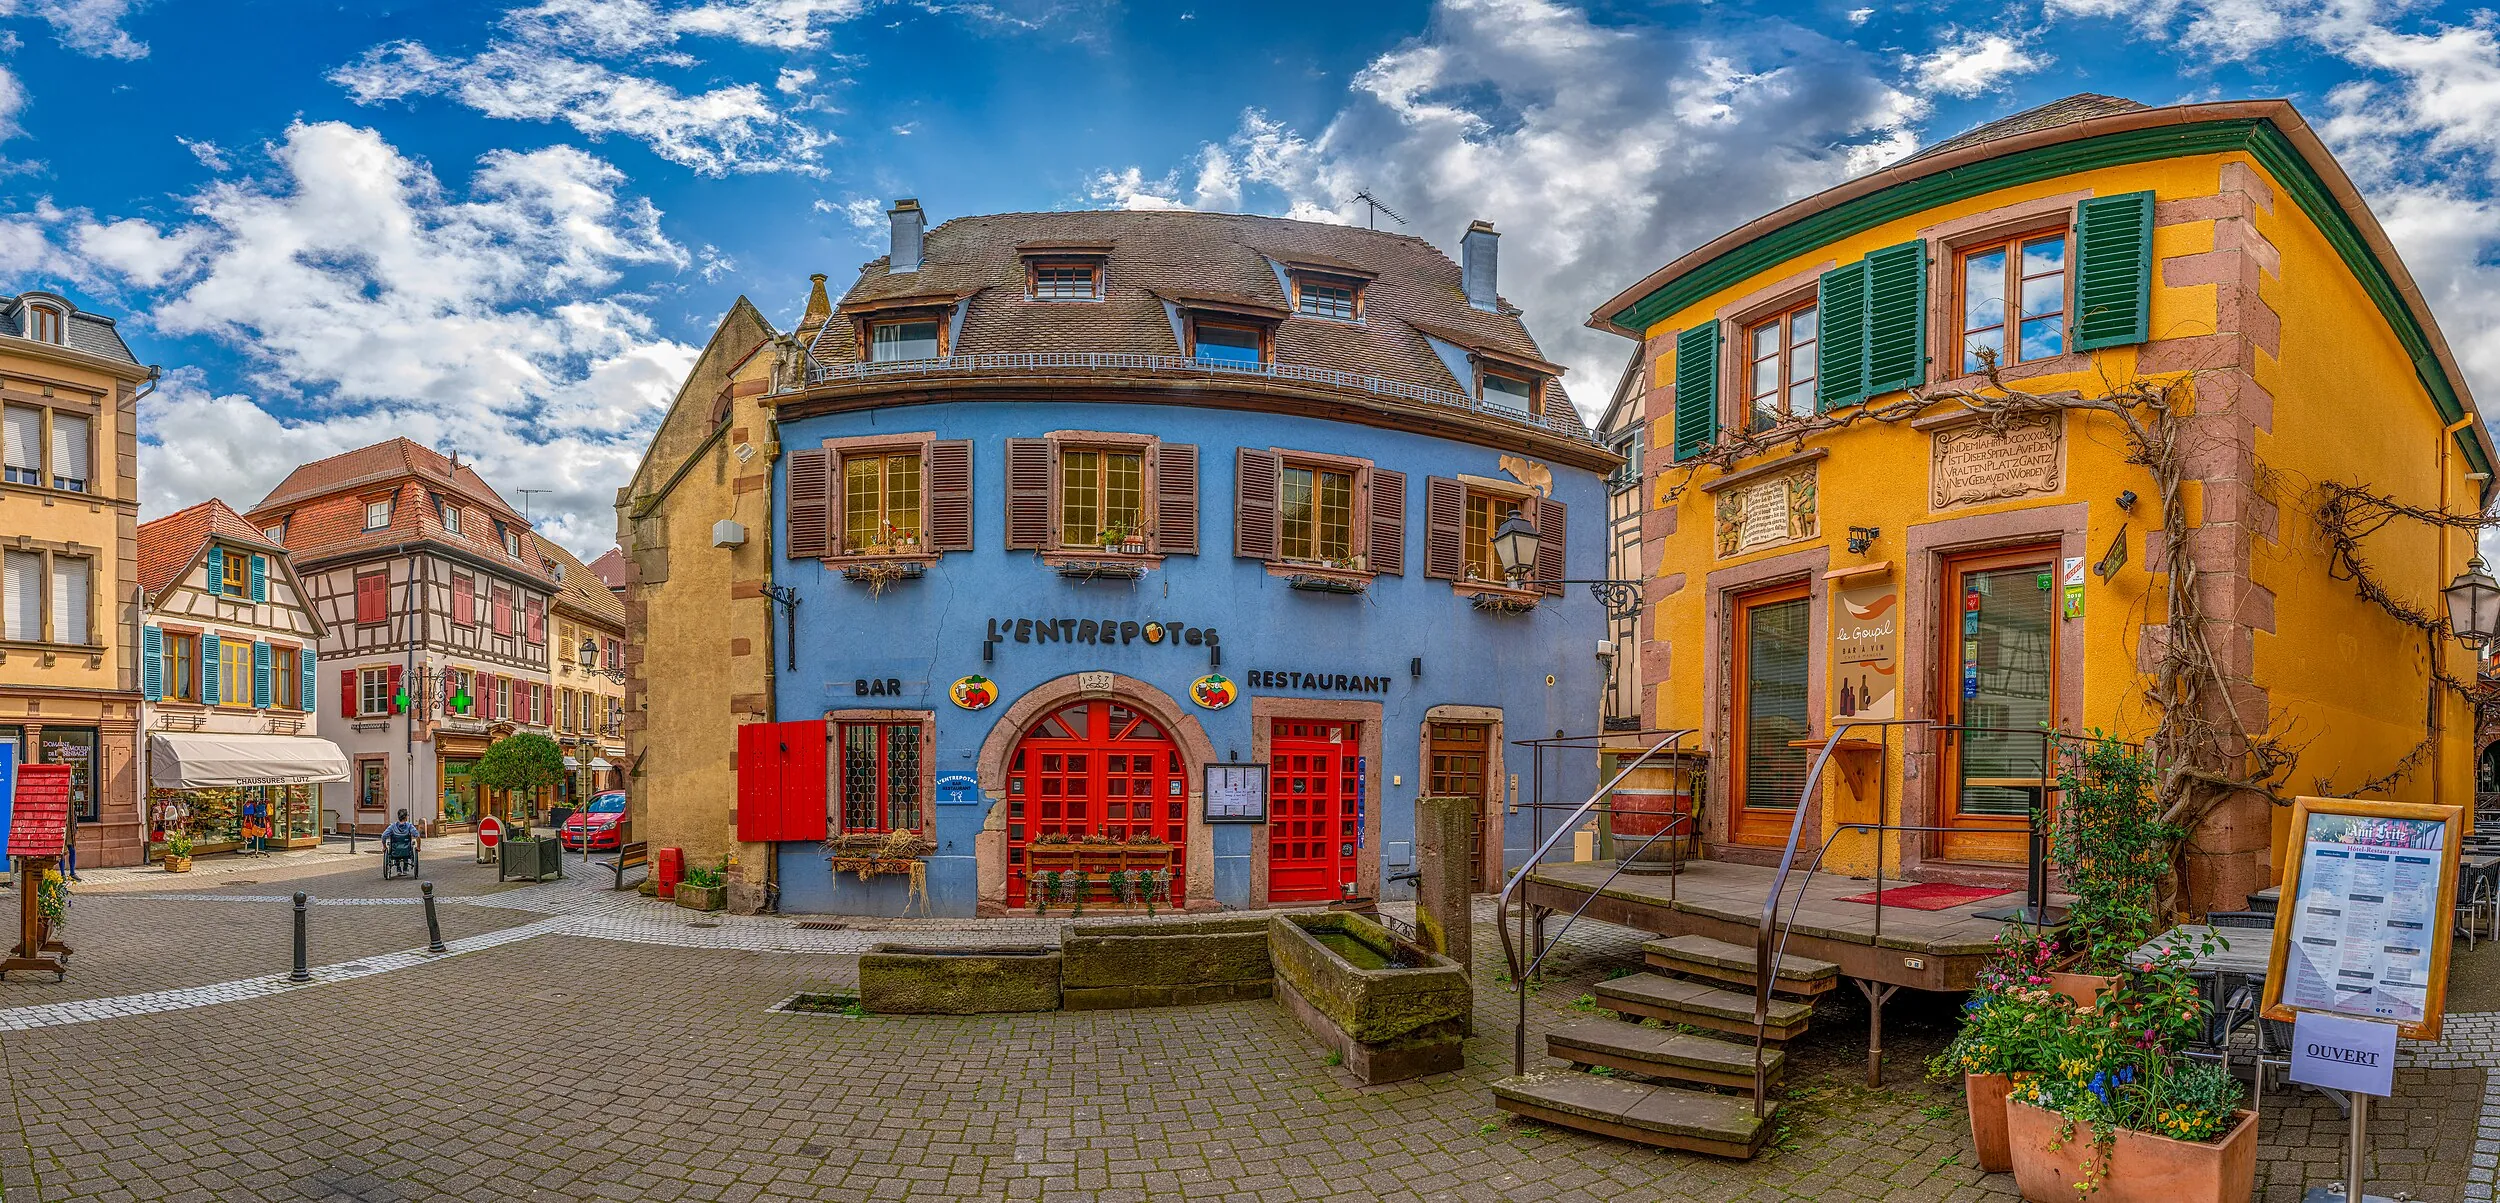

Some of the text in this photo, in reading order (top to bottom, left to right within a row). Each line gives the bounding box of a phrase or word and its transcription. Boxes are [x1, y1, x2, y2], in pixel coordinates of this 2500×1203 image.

[1948, 441, 2053, 466] IST DISER SPITAL AVF DEN
[1958, 441, 1978, 453] DEM
[1944, 453, 2053, 478] VRALTEN PLATZ GANTZ
[1968, 472, 2010, 486] GEBAVEN
[2009, 466, 2048, 480] WORDEN
[1852, 619, 1894, 646] Goupil
[1842, 646, 1856, 655] BAR
[1870, 644, 1885, 652] VIN
[855, 678, 901, 696] BAR
[1247, 669, 1392, 693] RESTAURANT
[236, 776, 309, 786] CHAUSSURES LUTZ
[2307, 1043, 2380, 1065] OUVERT
